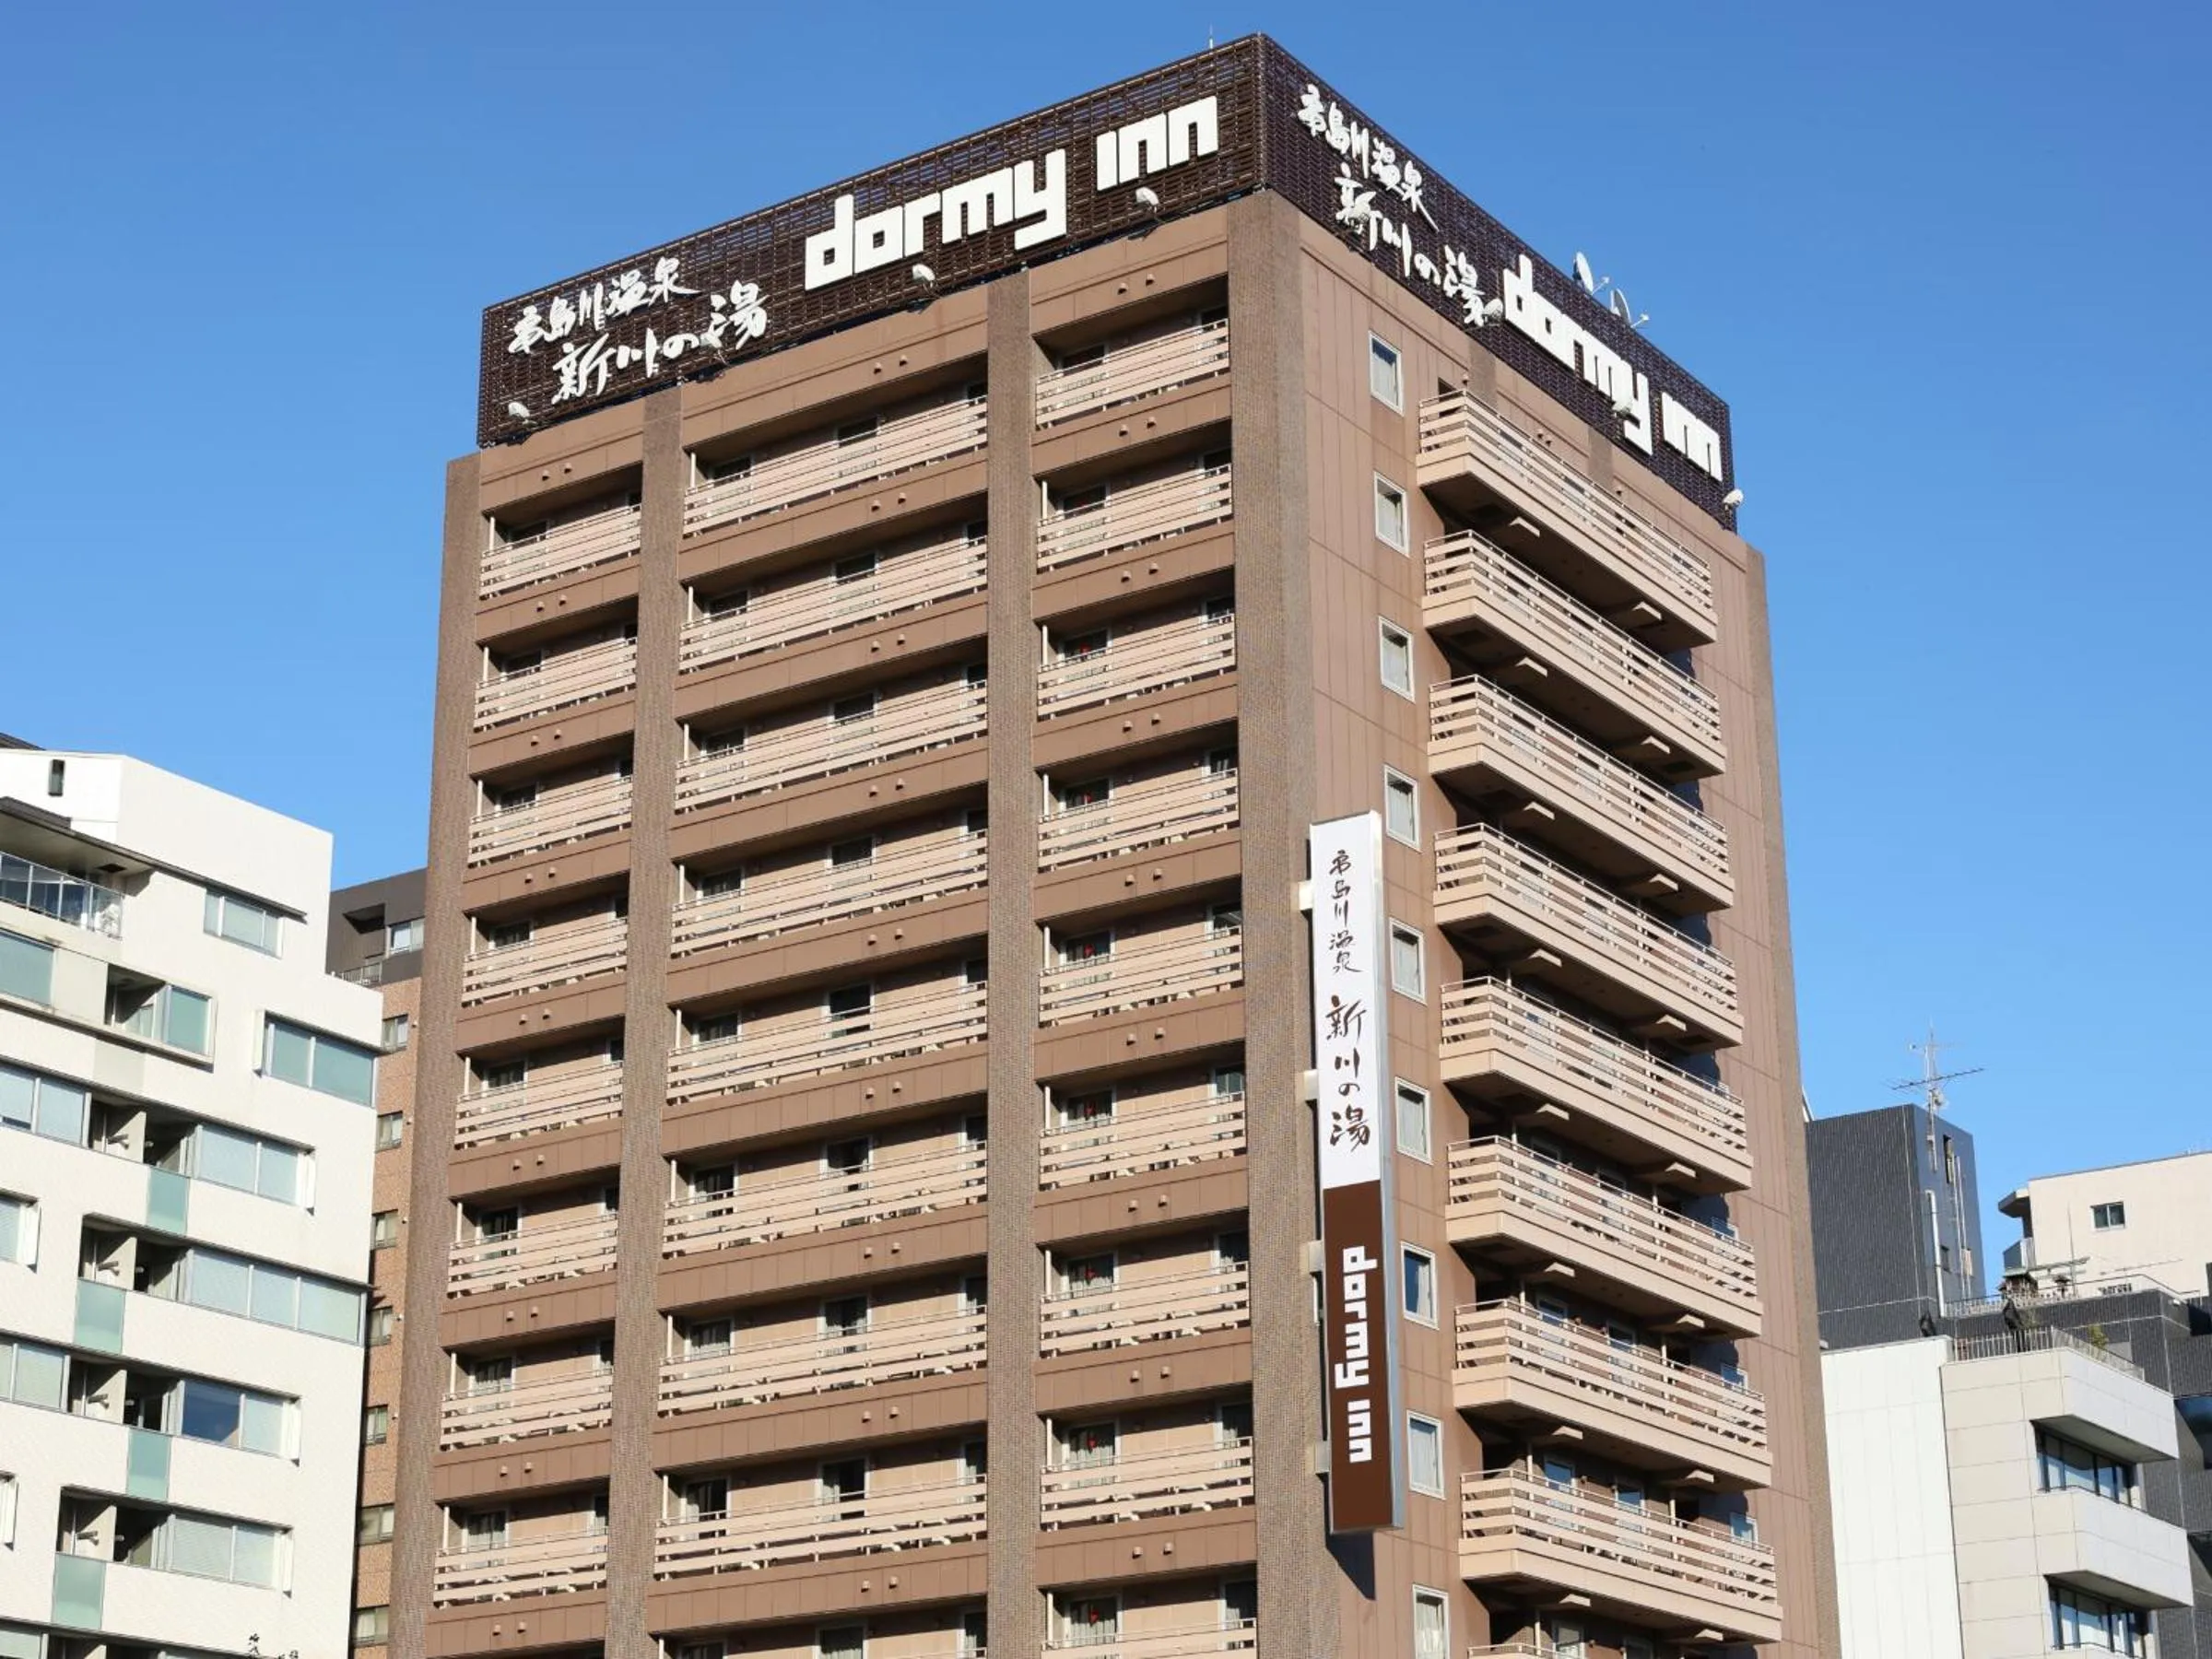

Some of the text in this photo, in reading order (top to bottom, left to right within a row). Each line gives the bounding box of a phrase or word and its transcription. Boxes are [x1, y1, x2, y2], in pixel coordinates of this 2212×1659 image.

[805, 96, 1218, 290] dormy inn
[1503, 254, 1723, 482] dormy inn
[1325, 994, 1371, 1152] 新川の湯
[1335, 1245, 1378, 1464] dormy inn
